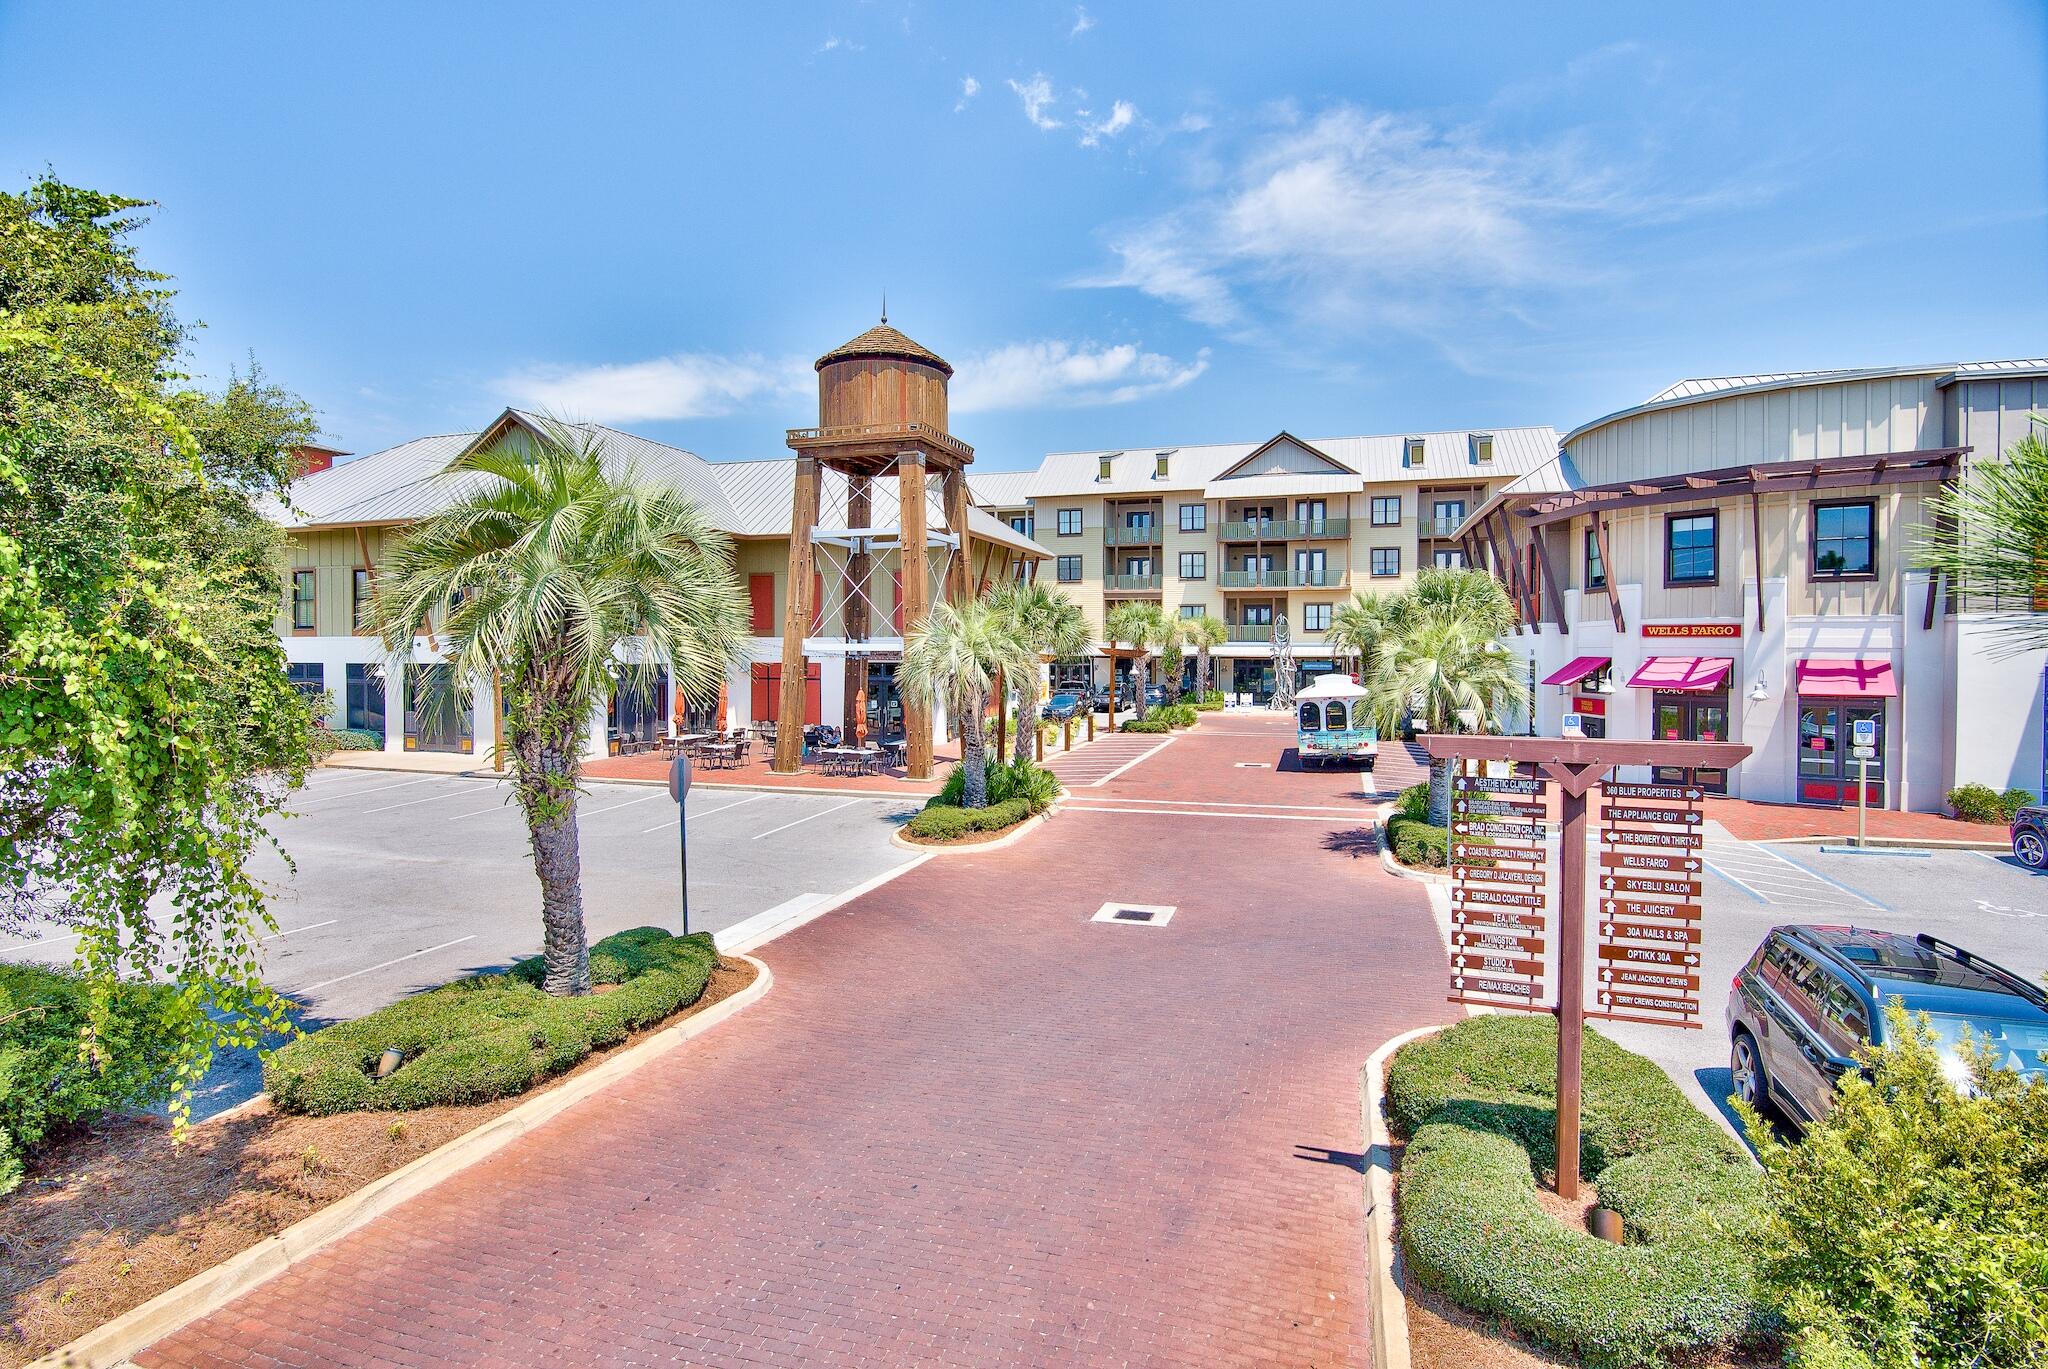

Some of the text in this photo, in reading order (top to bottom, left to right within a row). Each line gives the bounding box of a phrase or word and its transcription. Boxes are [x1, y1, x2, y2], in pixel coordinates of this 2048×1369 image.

[1647, 626, 1735, 635] WELLS FARGO
[1474, 778, 1539, 790] AESTHETIC CLINIQUE
[1606, 786, 1682, 798] 360 BLUE PROPERTIES
[1608, 809, 1678, 822] THE APPLIANCE GUY
[1469, 822, 1485, 831] BRAD
[1486, 824, 1520, 833] CONGLETON
[1622, 832, 1700, 846] THE BOWERY ON THIRTY-A
[1468, 847, 1544, 860] COASTAL SPECIALTY PHARMACY
[1623, 856, 1668, 868] WELLS FARGO
[1470, 869, 1493, 878] GREGORY
[1494, 872, 1498, 880] D
[1524, 874, 1543, 883] DESIGN
[1626, 880, 1690, 893] SKYEBLU SALON
[1472, 892, 1541, 906] EMERALD COAST TITLE
[1626, 903, 1674, 915] THE JUICERY
[1473, 920, 1508, 928] ENVIRONMENTAL
[1626, 927, 1688, 940] 30A NAILS & SPA
[1481, 934, 1518, 946] LIVINGSTON
[1484, 957, 1513, 967] STUDIO A
[1627, 950, 1671, 962] OPTIKK 30A
[1621, 973, 1688, 986] JEAN JACKSON CREWS
[1502, 984, 1530, 994] BEACHES
[1616, 995, 1697, 1010] TERRY CREWS CONSTRUCTION
